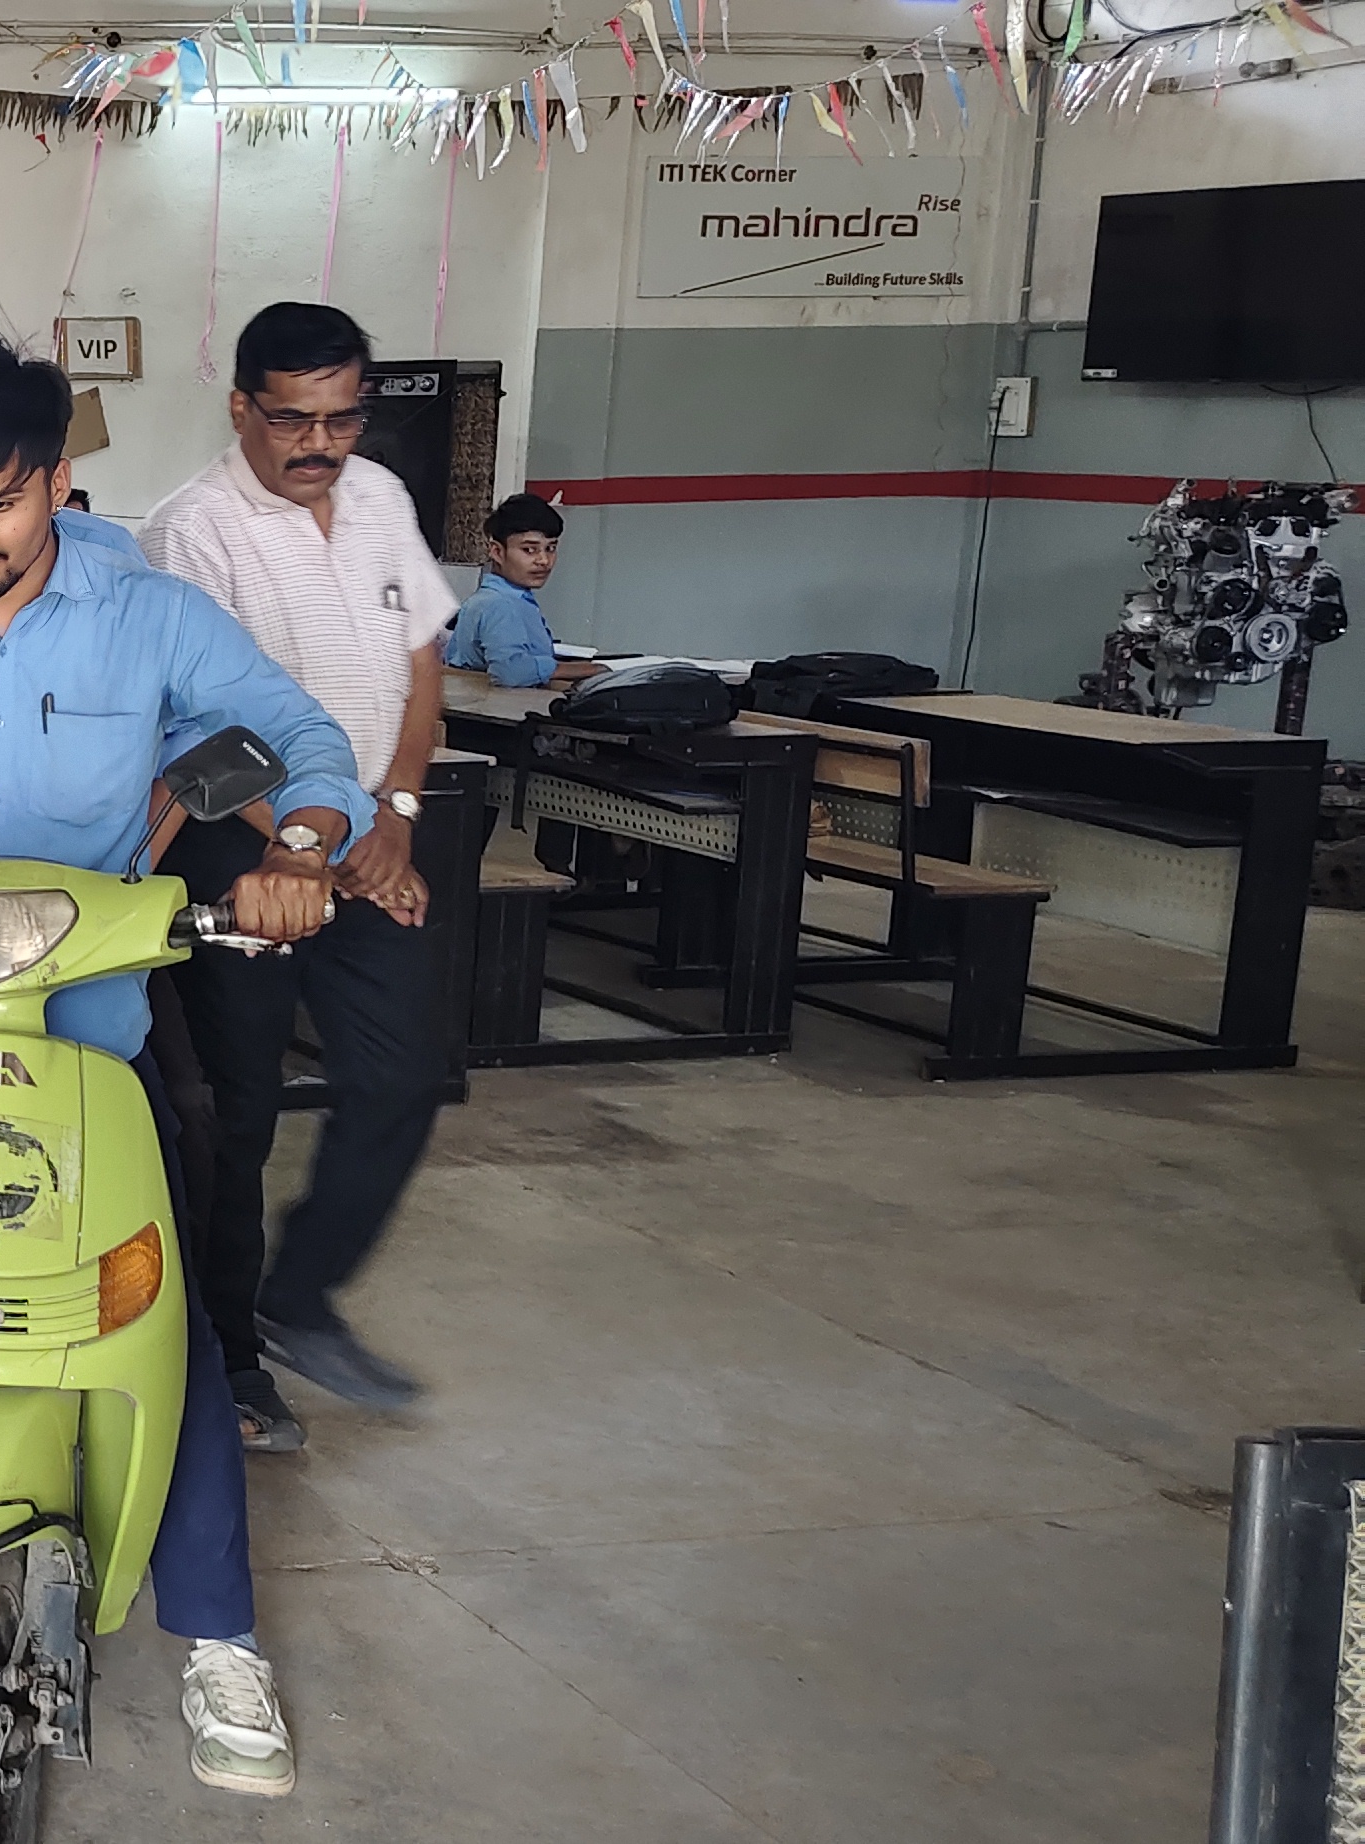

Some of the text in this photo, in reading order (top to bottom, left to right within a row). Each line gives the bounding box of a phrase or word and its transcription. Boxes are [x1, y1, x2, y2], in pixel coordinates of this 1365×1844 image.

[659, 164, 797, 183] ITI TEK Corner
[918, 194, 961, 212] Rise
[700, 207, 919, 238] mahindra
[883, 273, 927, 286] Future
[928, 272, 964, 286] Skills
[77, 339, 117, 359] VIP
